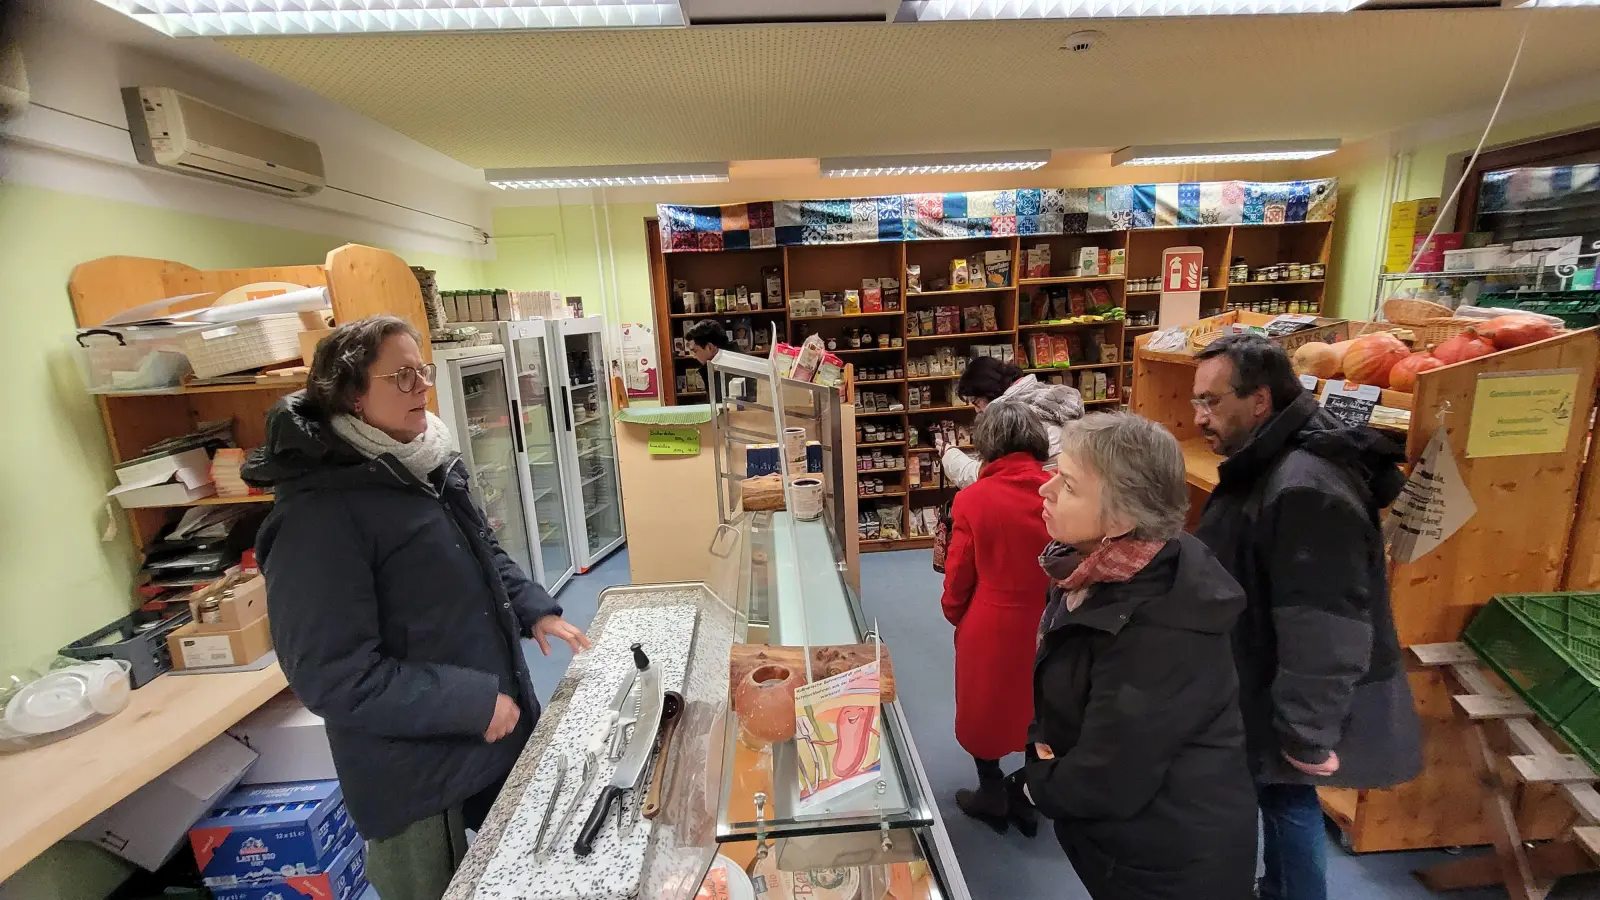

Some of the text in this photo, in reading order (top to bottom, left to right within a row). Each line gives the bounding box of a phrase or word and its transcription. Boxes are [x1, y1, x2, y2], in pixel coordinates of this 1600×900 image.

[236, 852, 276, 863] LATTE BIO
[769, 874, 779, 889] Bio
